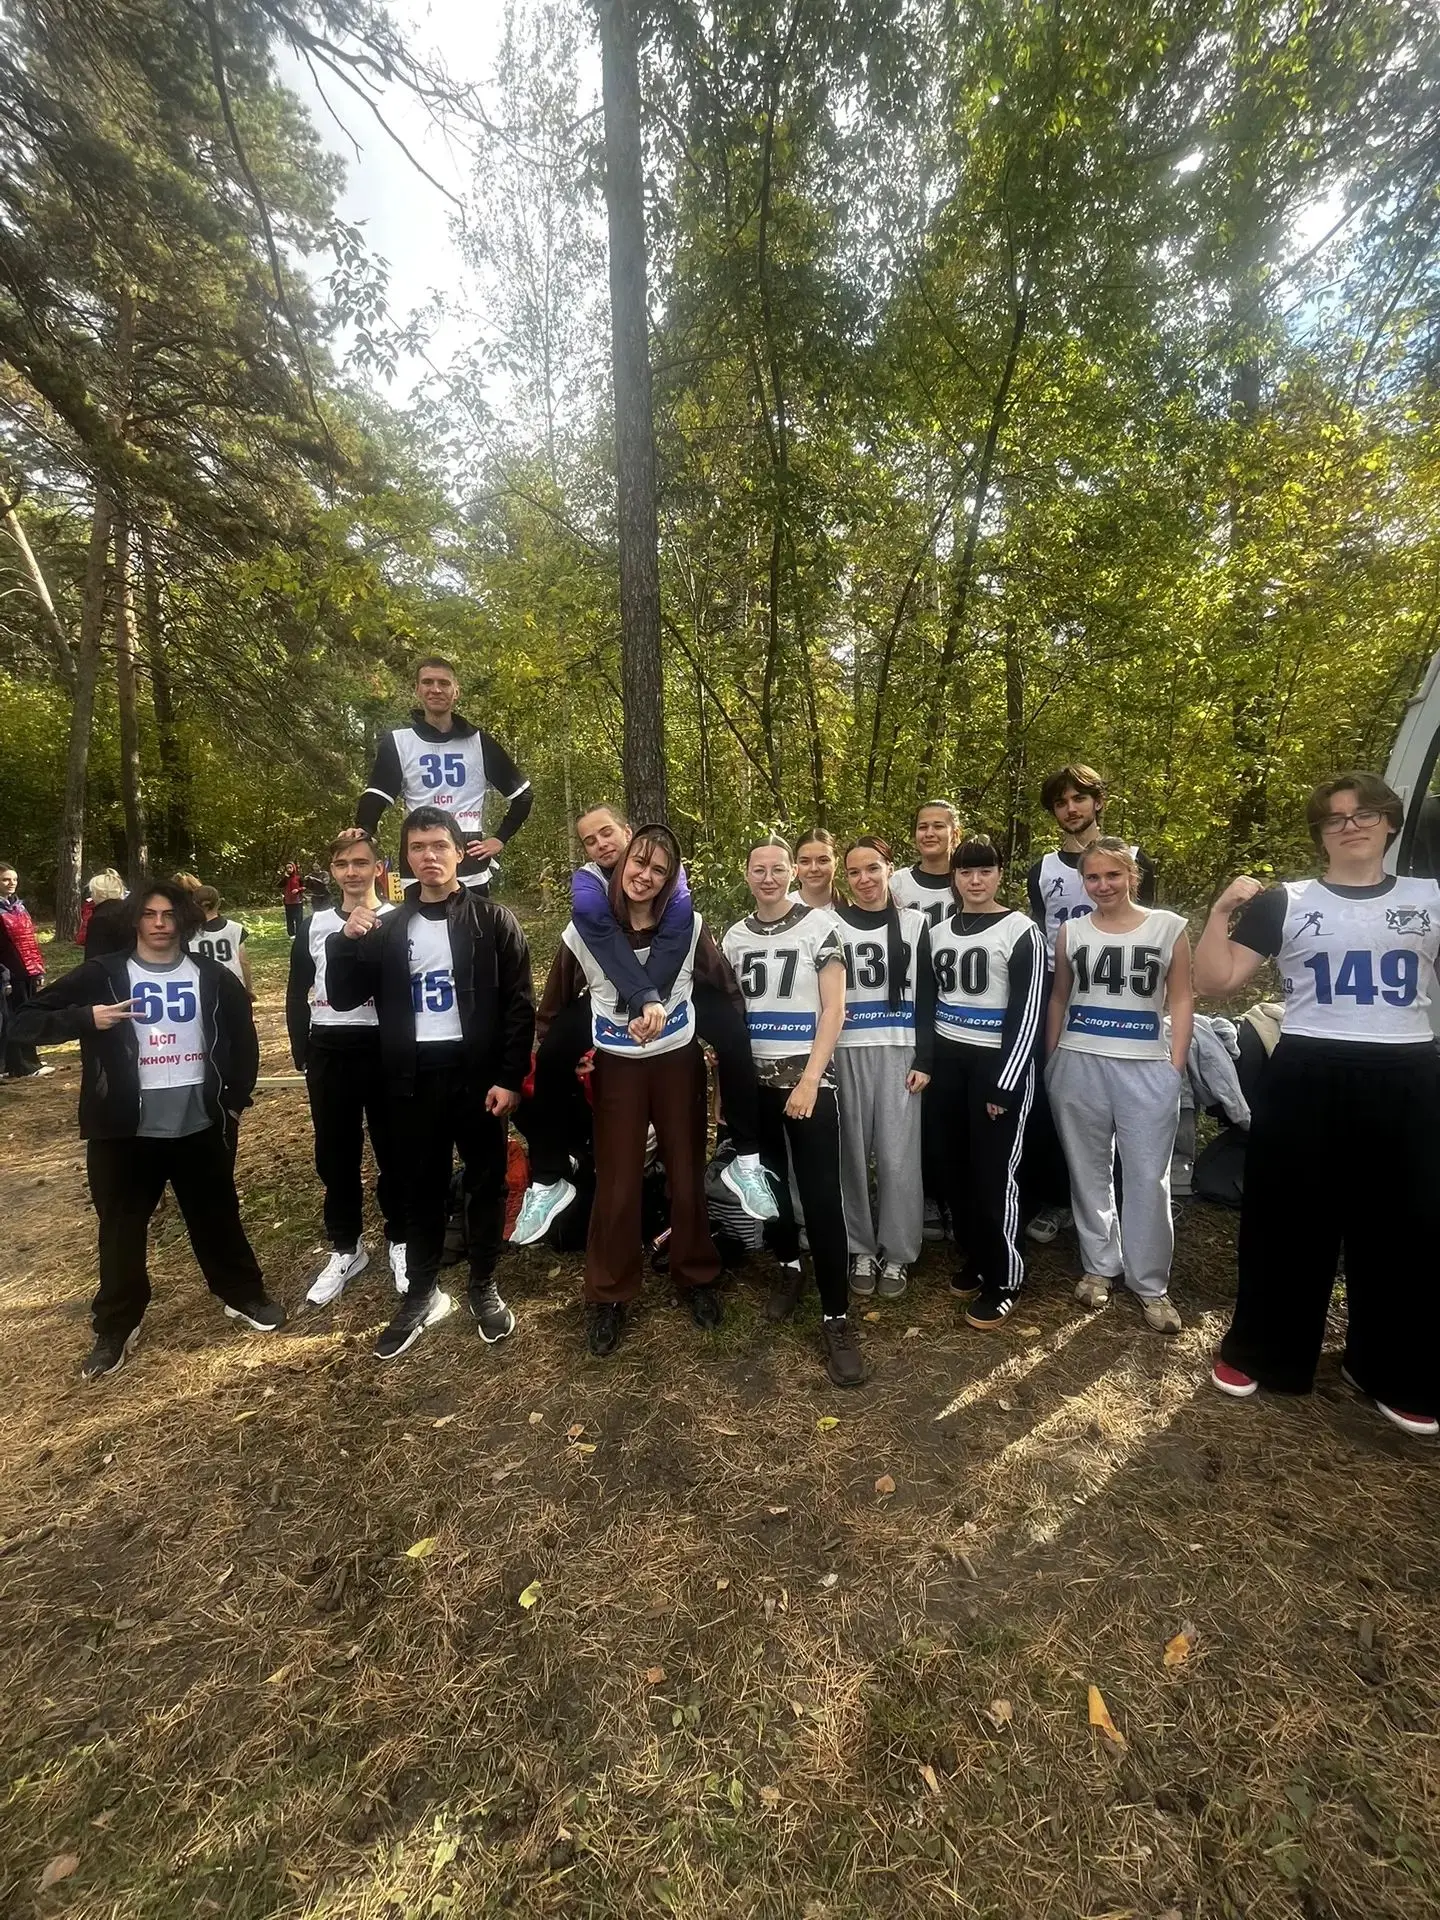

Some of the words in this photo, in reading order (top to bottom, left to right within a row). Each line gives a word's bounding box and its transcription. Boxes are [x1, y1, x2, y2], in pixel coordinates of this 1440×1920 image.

[419, 753, 466, 788] 35
[433, 795, 453, 805] ЦСП
[741, 949, 799, 999] 57
[933, 945, 990, 996] 80
[1072, 945, 1162, 998] 145
[1304, 949, 1419, 1007] 149
[132, 981, 196, 1025] 65
[149, 1033, 177, 1046] ЦСП
